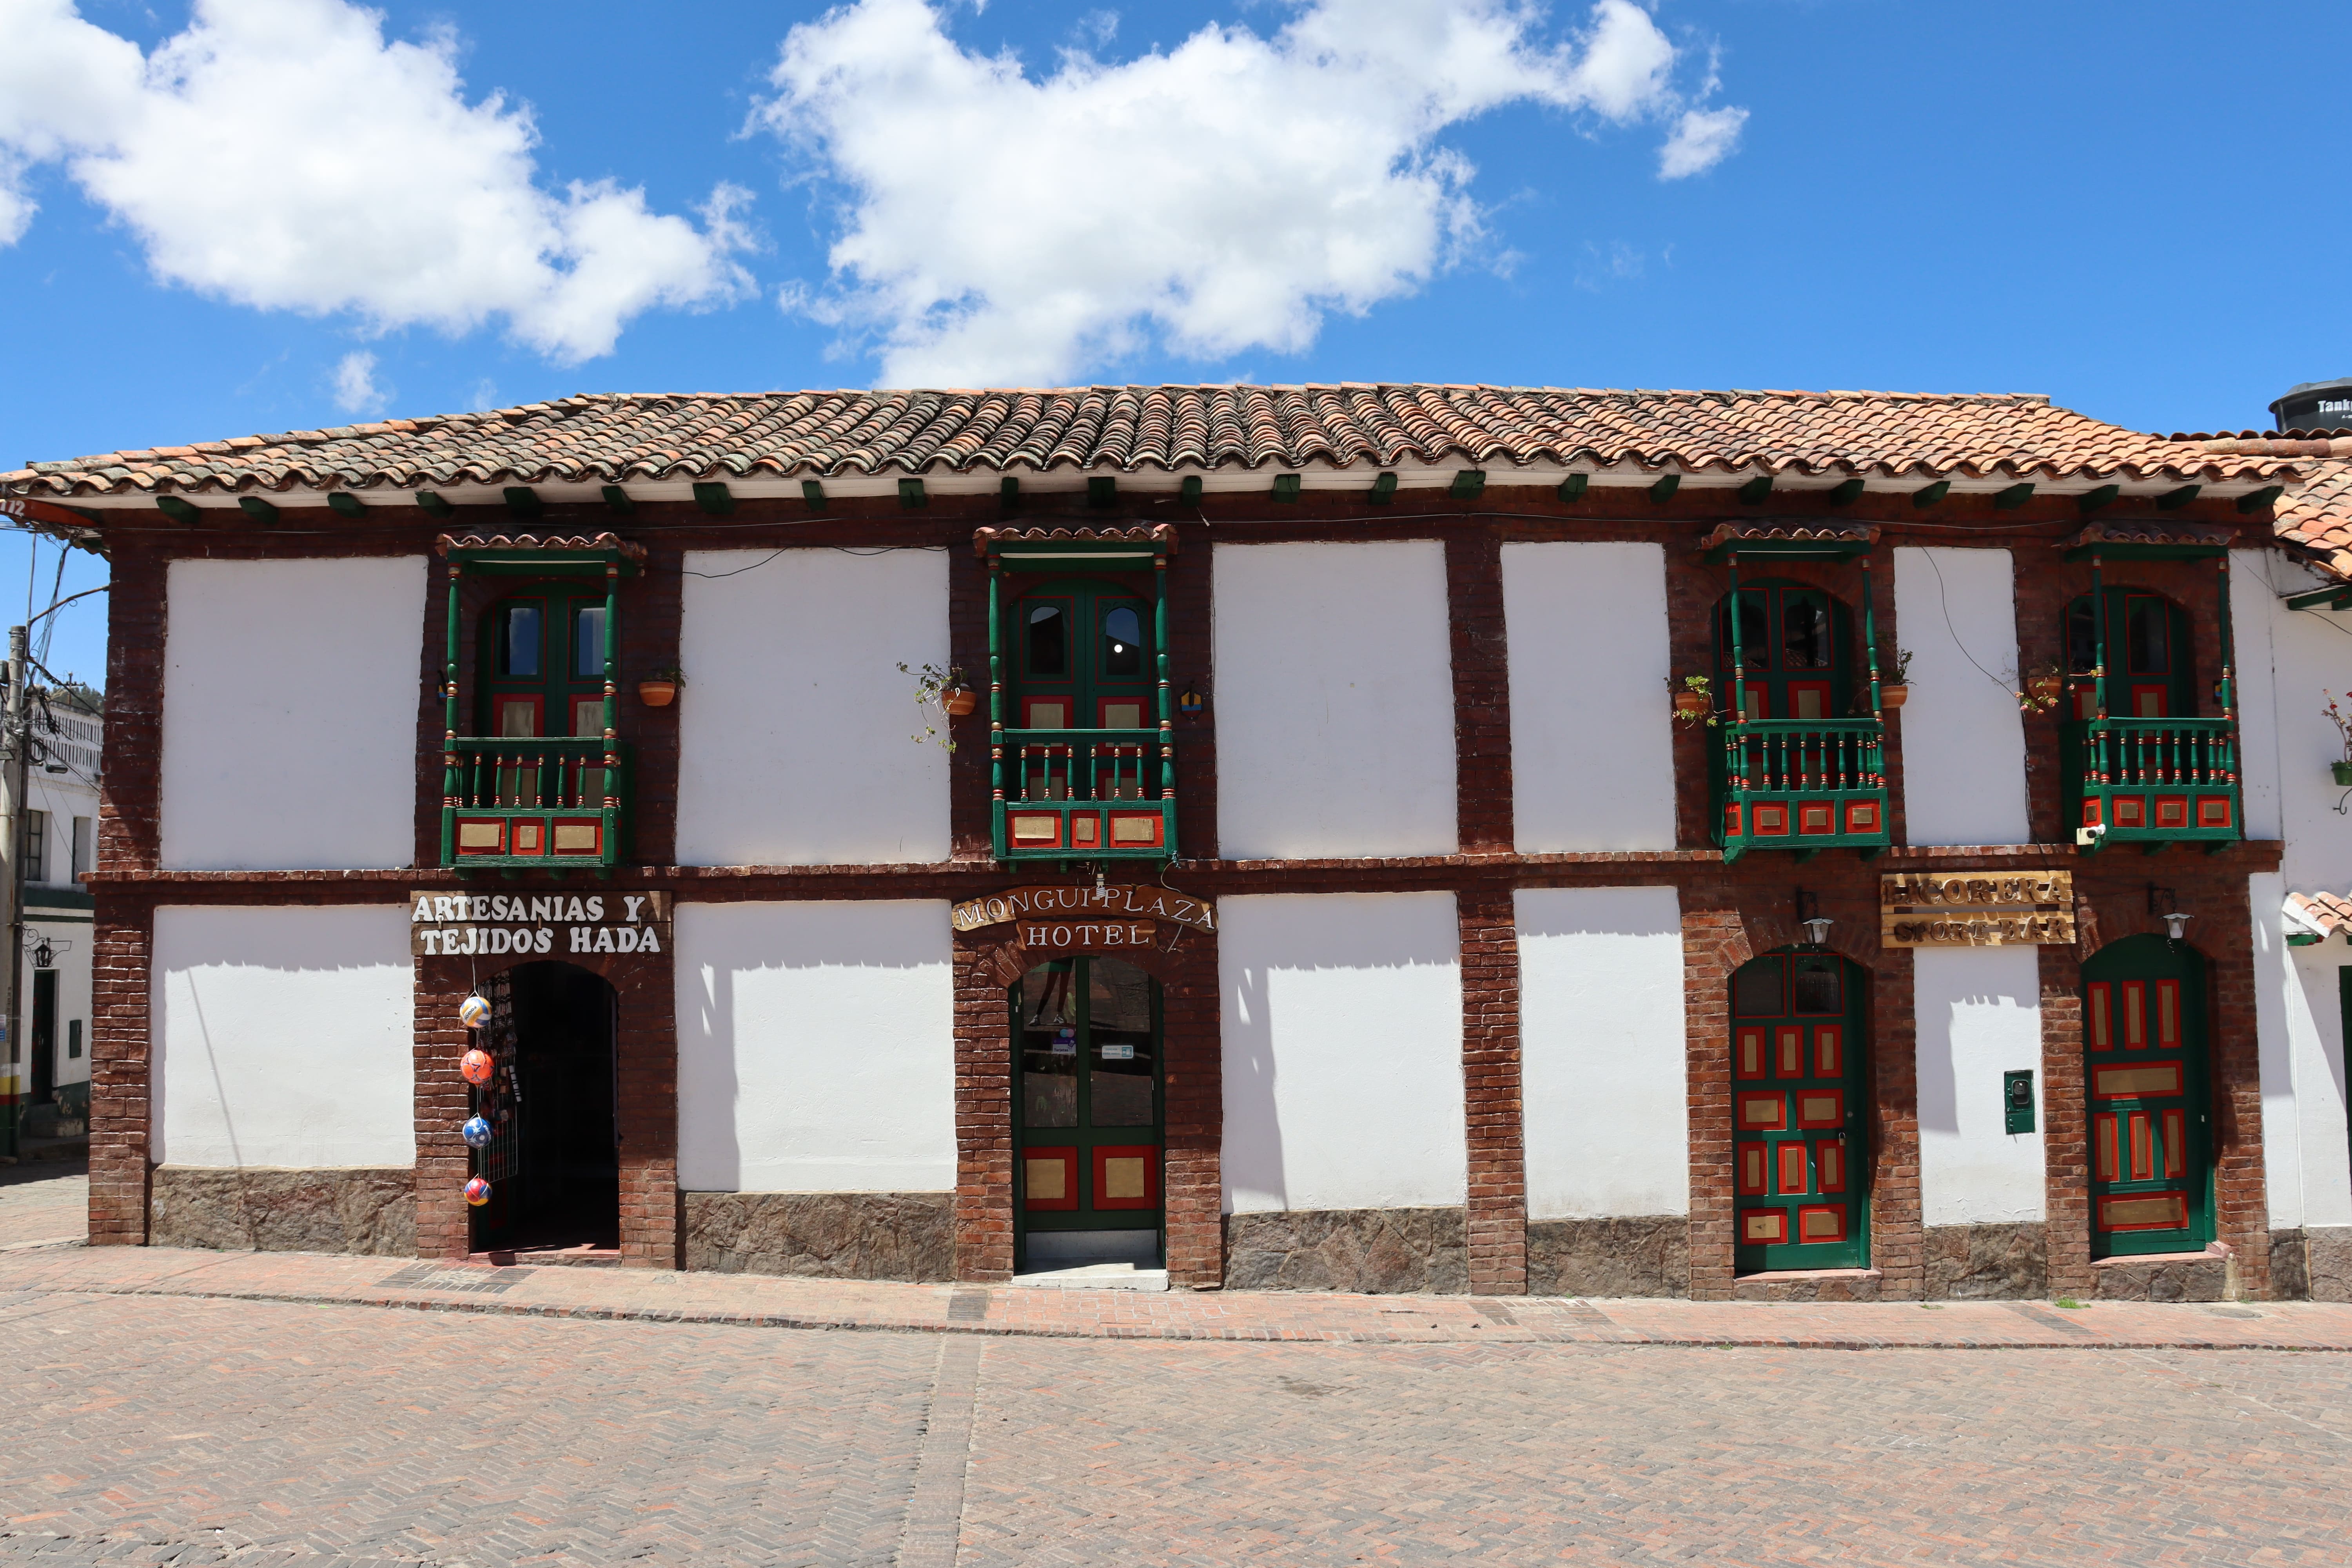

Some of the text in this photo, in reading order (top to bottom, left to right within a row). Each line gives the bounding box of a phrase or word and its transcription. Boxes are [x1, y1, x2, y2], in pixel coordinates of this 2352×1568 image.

[2318, 399, 2352, 412] Tank
[1883, 876, 2073, 905] LICORERA
[411, 895, 646, 922] ARTESANIAS Y
[1102, 888, 1215, 930] PLAZA
[420, 926, 661, 955] TEJIDOS HADA
[1026, 925, 1149, 946] HOTEL
[1895, 916, 2070, 942] SPORT BAR
